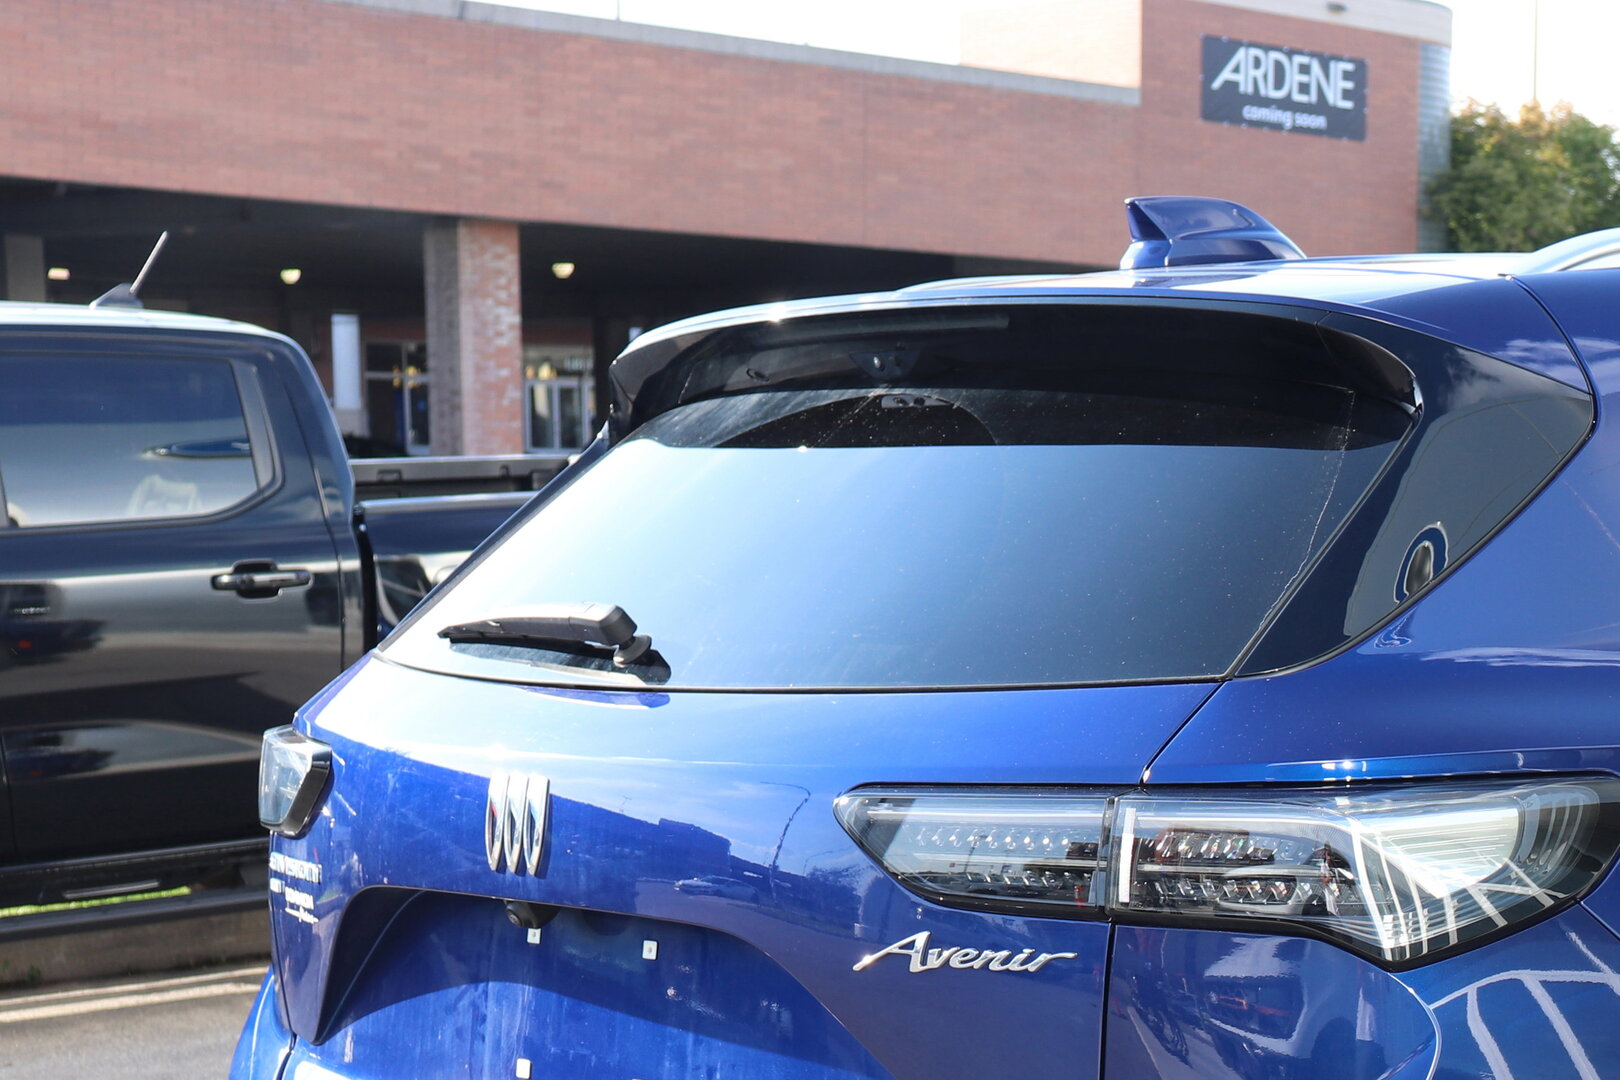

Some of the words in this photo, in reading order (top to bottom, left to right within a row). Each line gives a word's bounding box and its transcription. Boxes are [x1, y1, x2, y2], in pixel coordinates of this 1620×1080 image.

[1210, 46, 1356, 110] ARDENE
[1241, 104, 1293, 130] coming
[1294, 112, 1328, 131] soon
[852, 930, 1079, 973] Avenir
